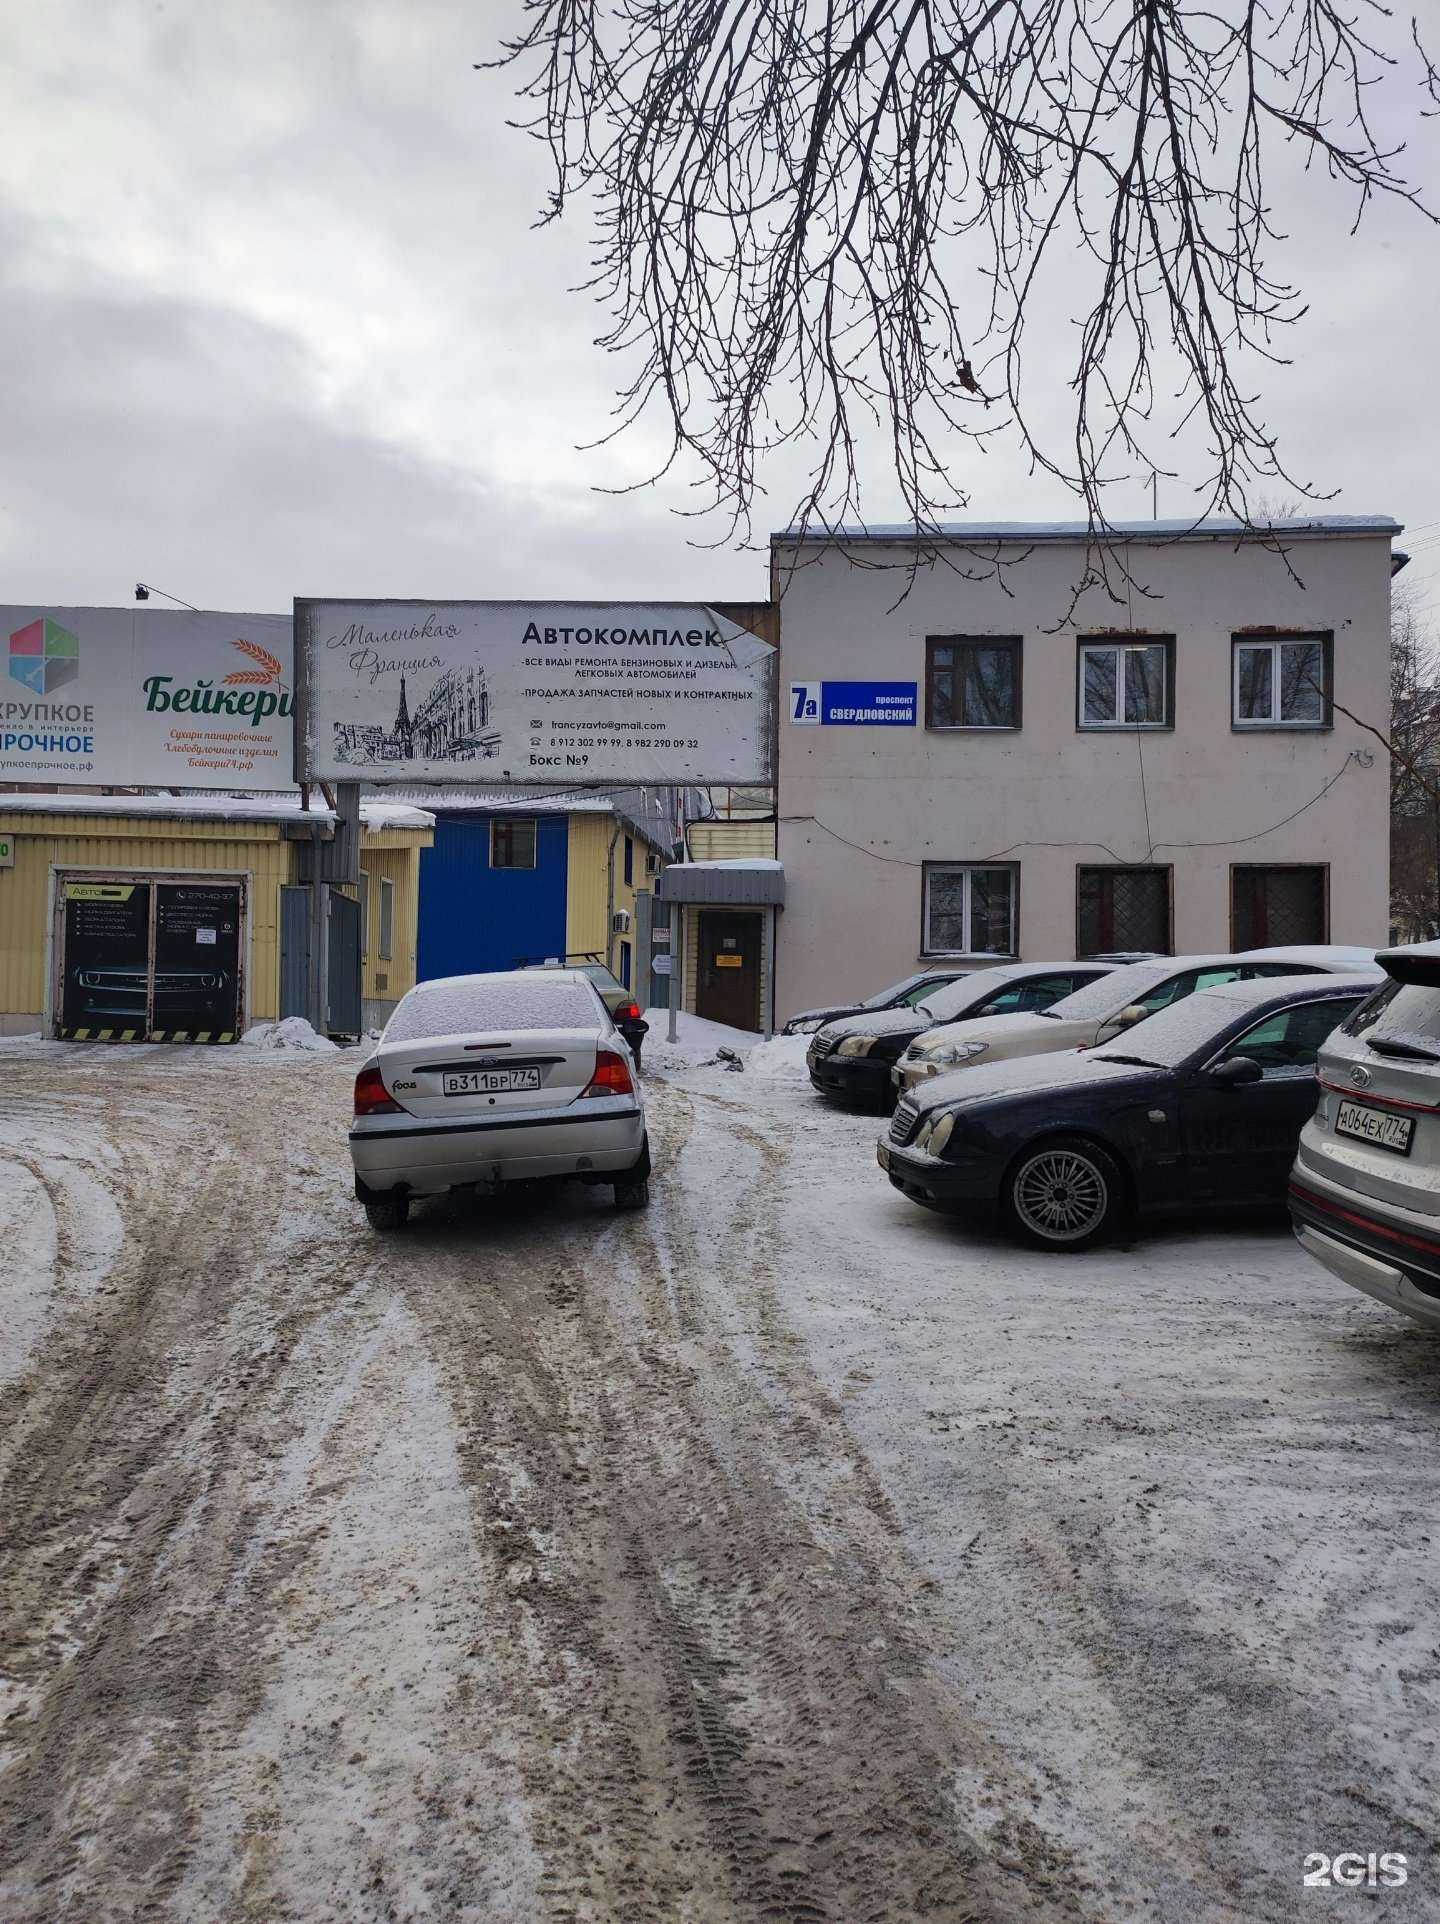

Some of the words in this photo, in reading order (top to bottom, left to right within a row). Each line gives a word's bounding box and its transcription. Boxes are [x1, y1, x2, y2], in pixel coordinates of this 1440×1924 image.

[327, 613, 462, 649] Маленькая
[349, 647, 444, 685] Франция
[545, 658, 572, 668] ВИДЫ
[574, 658, 618, 667] РЕМОНТА
[621, 658, 683, 668] БЕНЗИНОВЫХ
[685, 660, 692, 668] И
[574, 669, 624, 678] ЛЕГКОВЫХ
[626, 669, 697, 679] АВТОМОБИЛЕЙ
[578, 687, 634, 698] ЗАПЧАСТЕЙ
[636, 689, 672, 699] НОВЫХ
[674, 690, 681, 698] И
[683, 690, 753, 701] КОНТРАКТНЫХ
[875, 696, 913, 705] проспект
[829, 707, 913, 721] СВЕРДЛОВСКИЙ
[169, 728, 203, 741] Сухари
[204, 730, 273, 742] панировочные
[550, 738, 556, 748] 8
[558, 738, 575, 748] 912
[577, 738, 594, 748] 302
[597, 738, 608, 748] 99
[626, 738, 633, 748] 8
[635, 738, 651, 748] 982
[654, 738, 671, 748] 290
[673, 738, 685, 748] 09
[687, 738, 698, 748] 32
[163, 742, 237, 756] Хлебобулочные
[239, 747, 279, 760] изделия
[529, 754, 561, 766] Бокс
[566, 754, 589, 766] №9
[511, 1070, 538, 1083] 774
